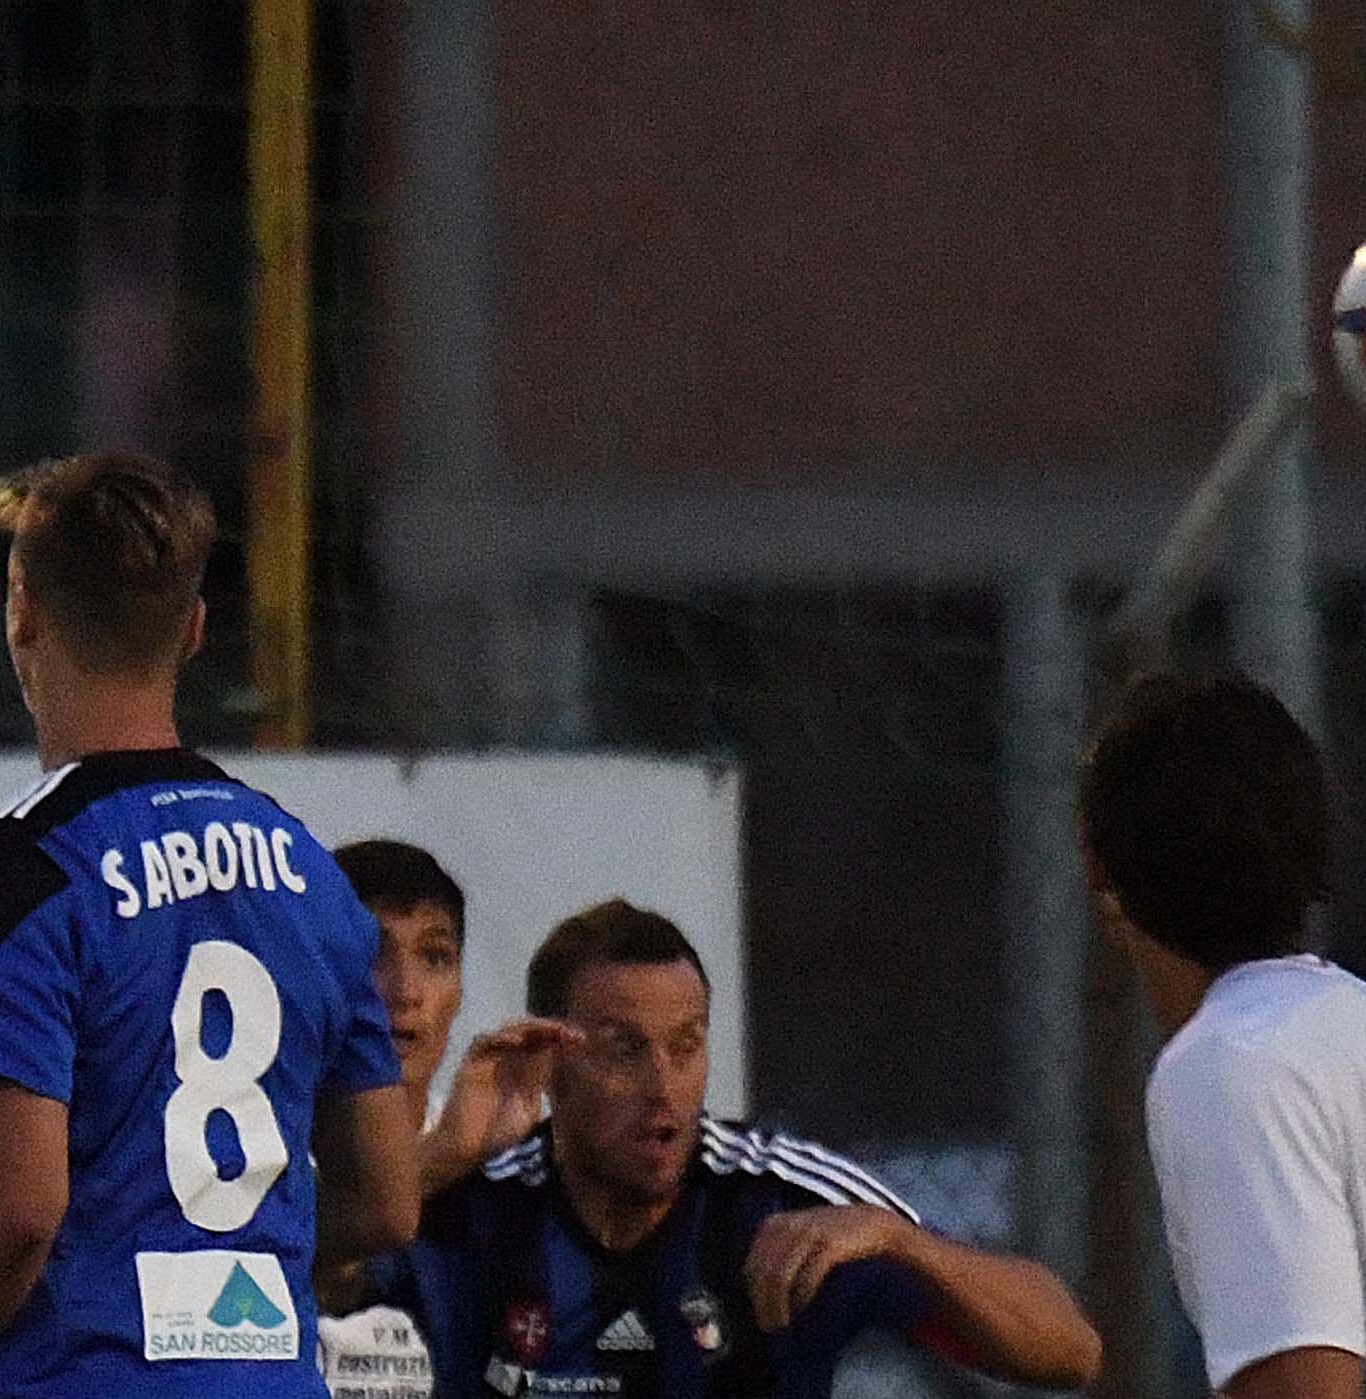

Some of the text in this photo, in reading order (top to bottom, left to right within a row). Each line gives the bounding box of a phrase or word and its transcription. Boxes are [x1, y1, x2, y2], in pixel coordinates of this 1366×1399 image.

[101, 821, 307, 919] SABOTIC
[164, 938, 290, 1233] 8
[151, 1331, 293, 1356] SAN ROSSORE
